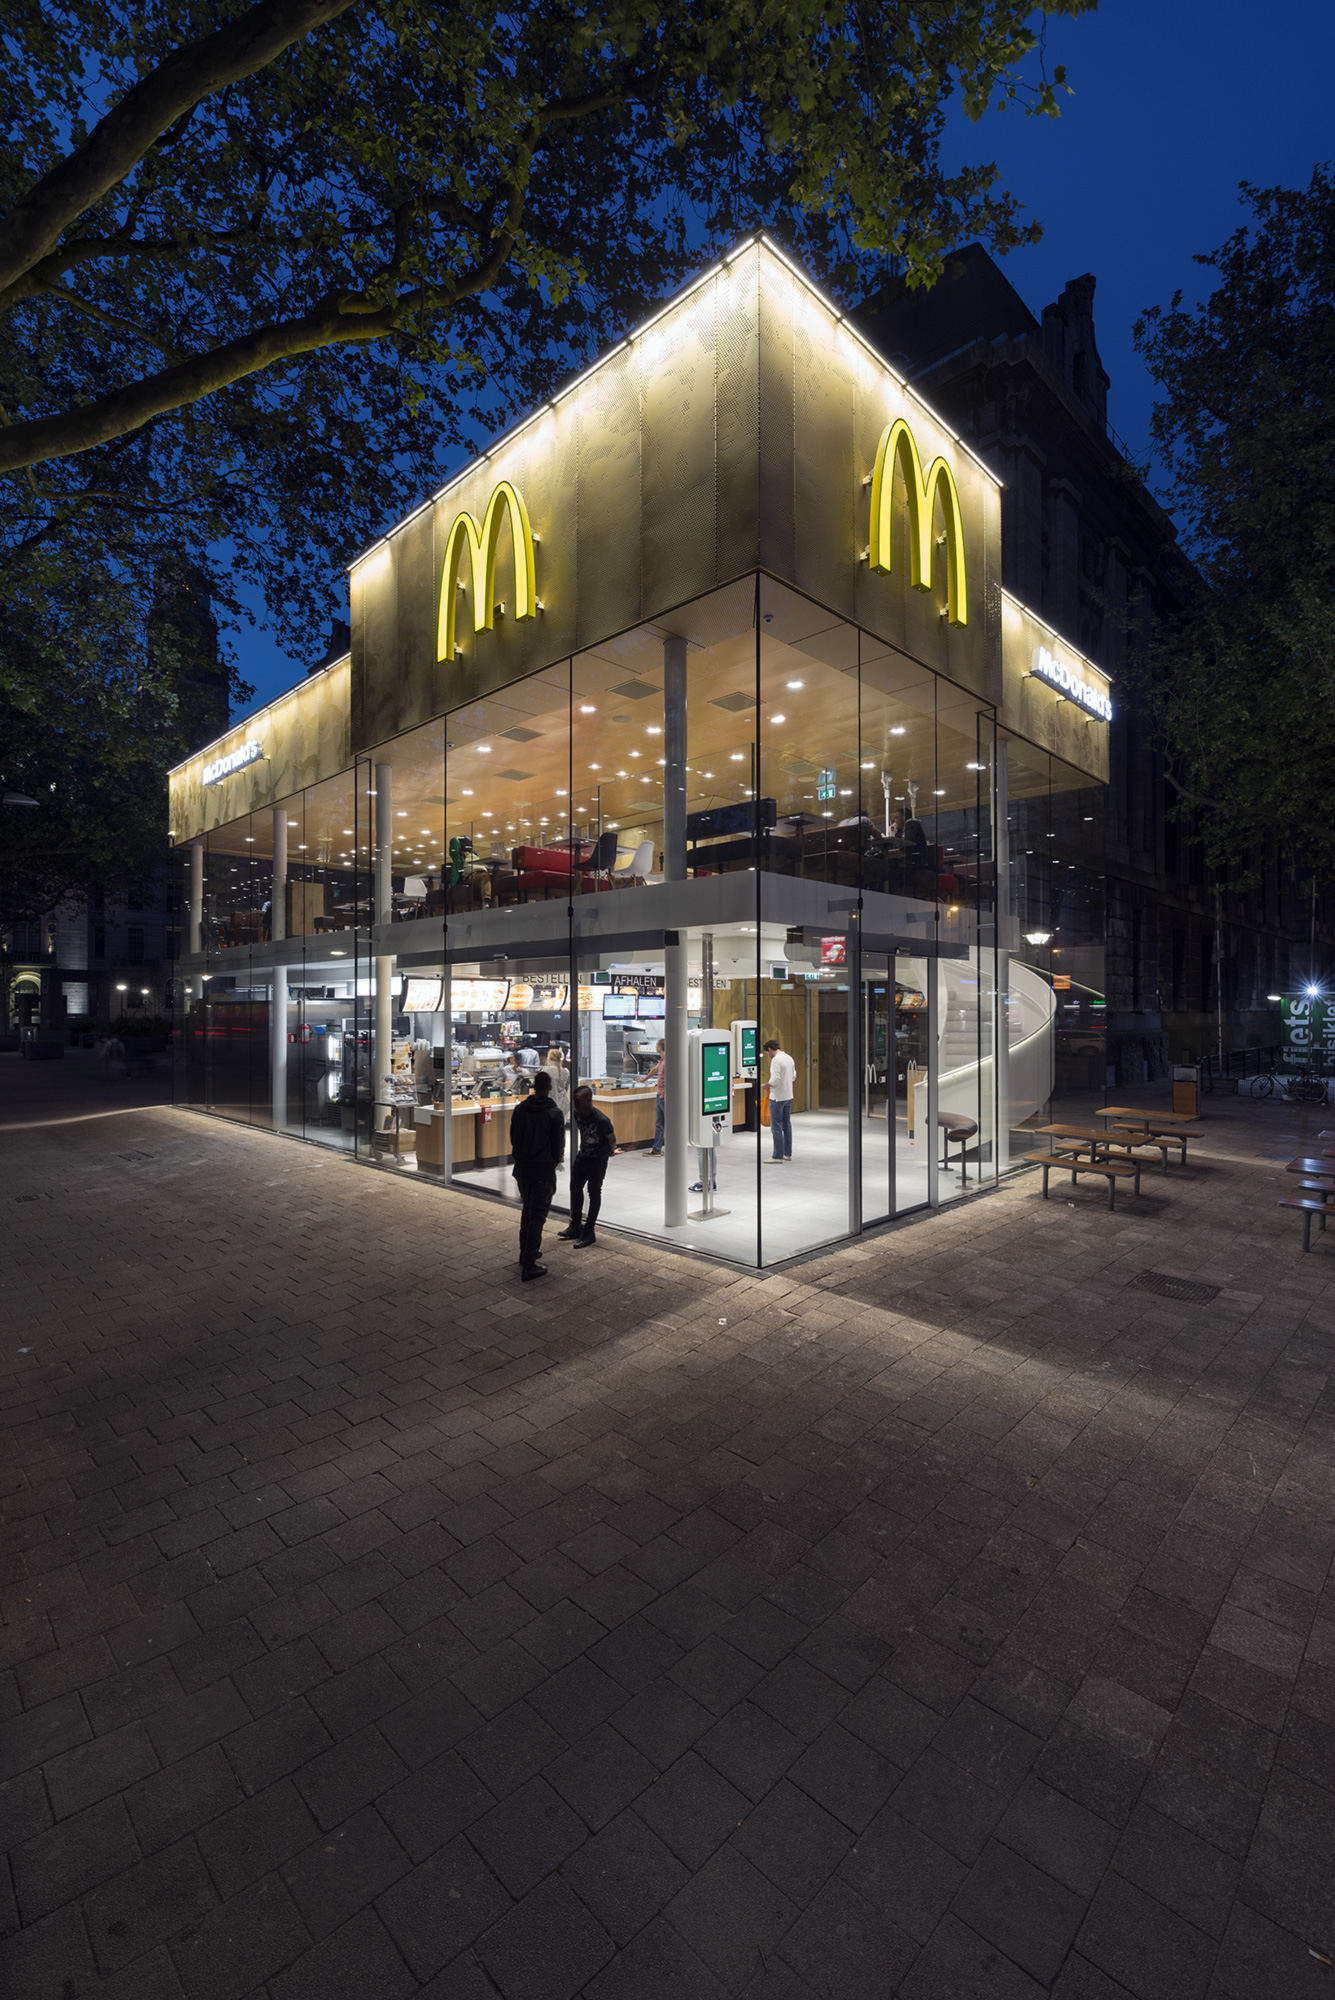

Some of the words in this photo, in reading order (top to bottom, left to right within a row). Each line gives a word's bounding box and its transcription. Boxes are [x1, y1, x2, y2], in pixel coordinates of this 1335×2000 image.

[1036, 646, 1112, 722] McDonald's
[202, 739, 261, 786] McDonald's
[522, 973, 582, 985] BESTELLN
[614, 975, 657, 987] AFHALEN
[1282, 998, 1314, 1065] fiets
